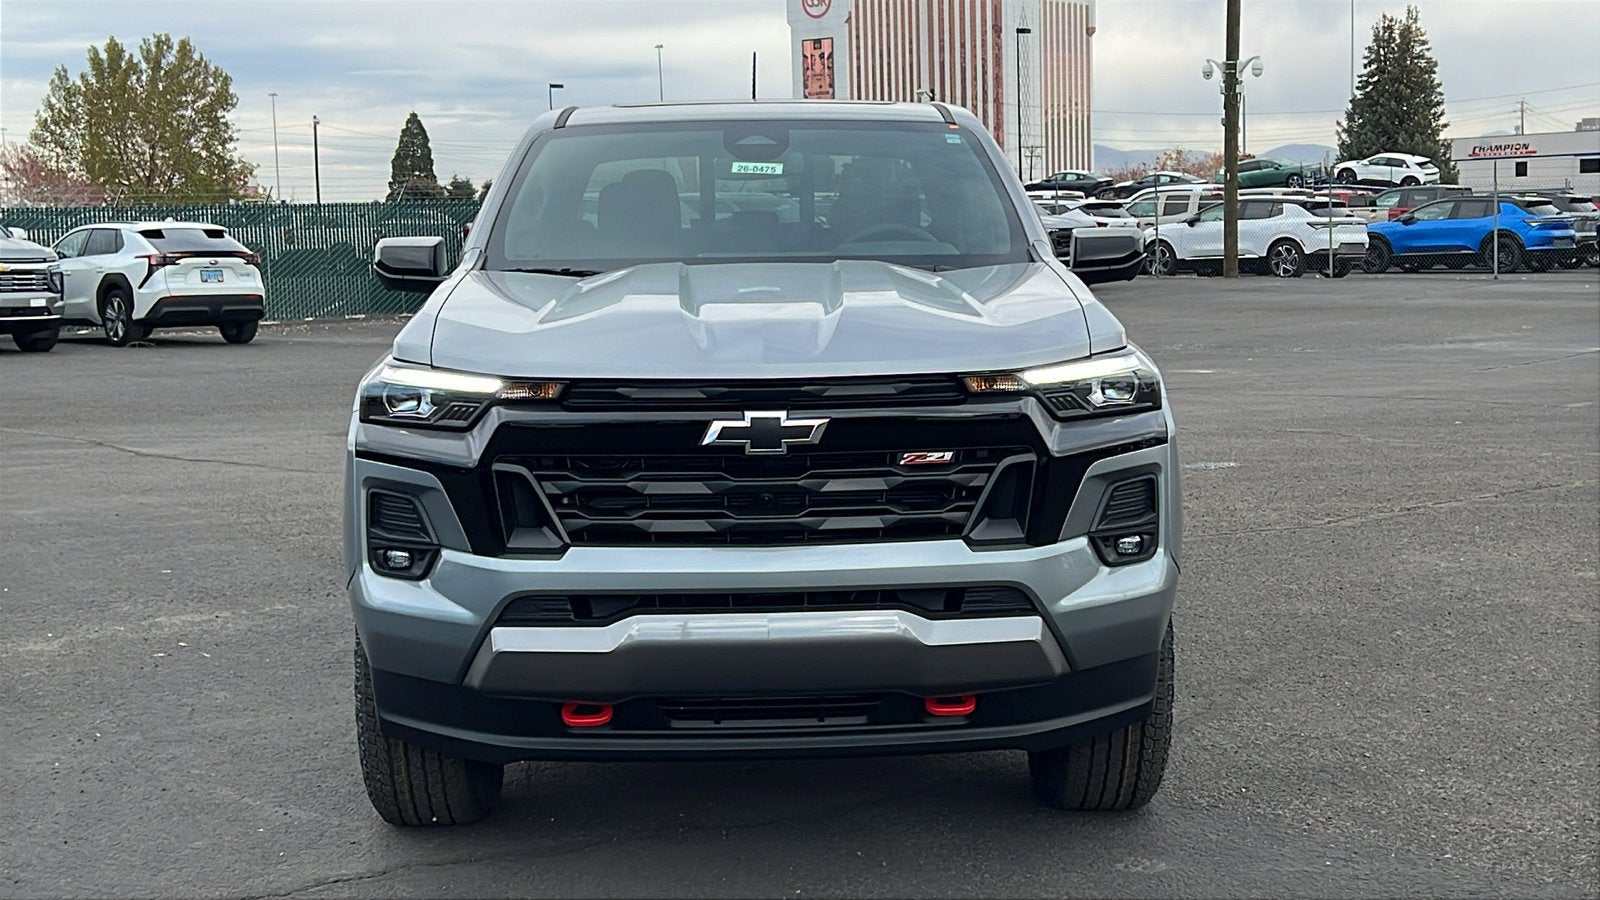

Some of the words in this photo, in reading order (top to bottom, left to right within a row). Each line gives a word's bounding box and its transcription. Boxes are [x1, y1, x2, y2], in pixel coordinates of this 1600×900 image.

[1472, 143, 1530, 154] CHAMPION
[737, 165, 777, 173] 26-0475
[900, 451, 953, 465] Z71
